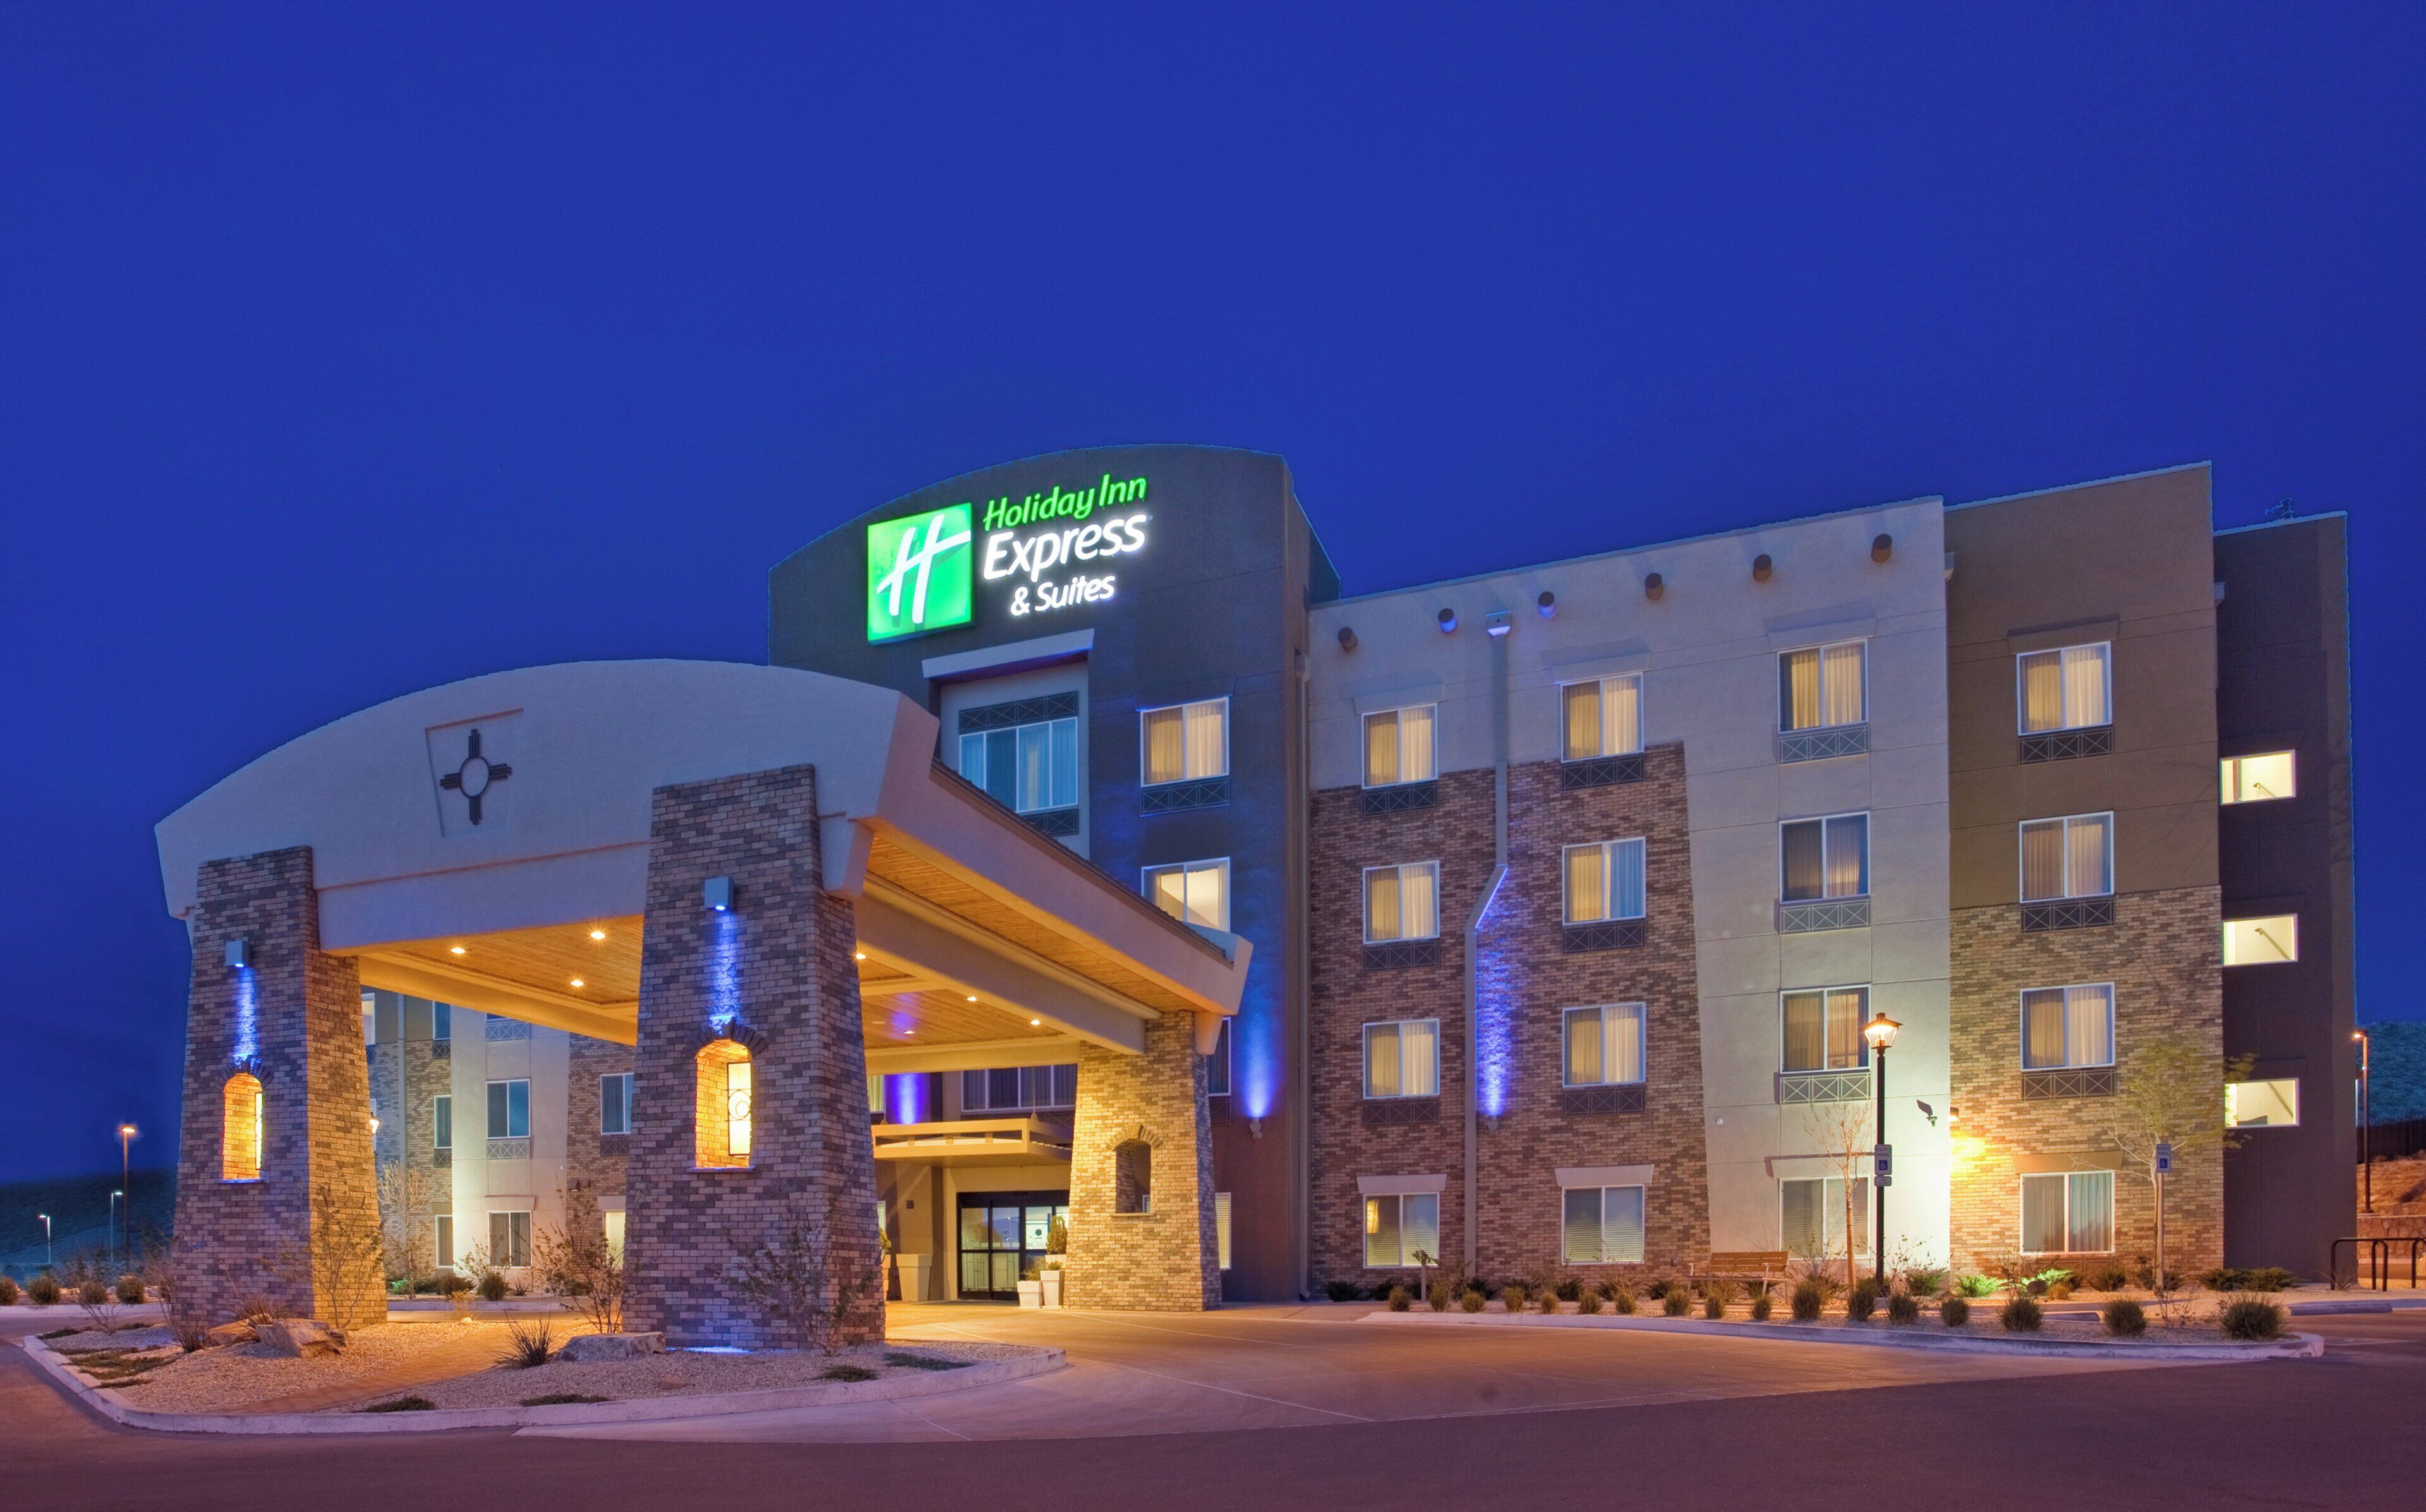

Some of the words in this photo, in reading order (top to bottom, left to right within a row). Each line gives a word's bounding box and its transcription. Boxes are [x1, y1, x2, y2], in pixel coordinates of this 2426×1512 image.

[982, 486, 1095, 532] Holiday
[1098, 474, 1147, 507] Inn
[877, 514, 971, 624] H
[983, 513, 1147, 583] Express
[1010, 586, 1030, 616] &
[1034, 575, 1116, 612] Suites
